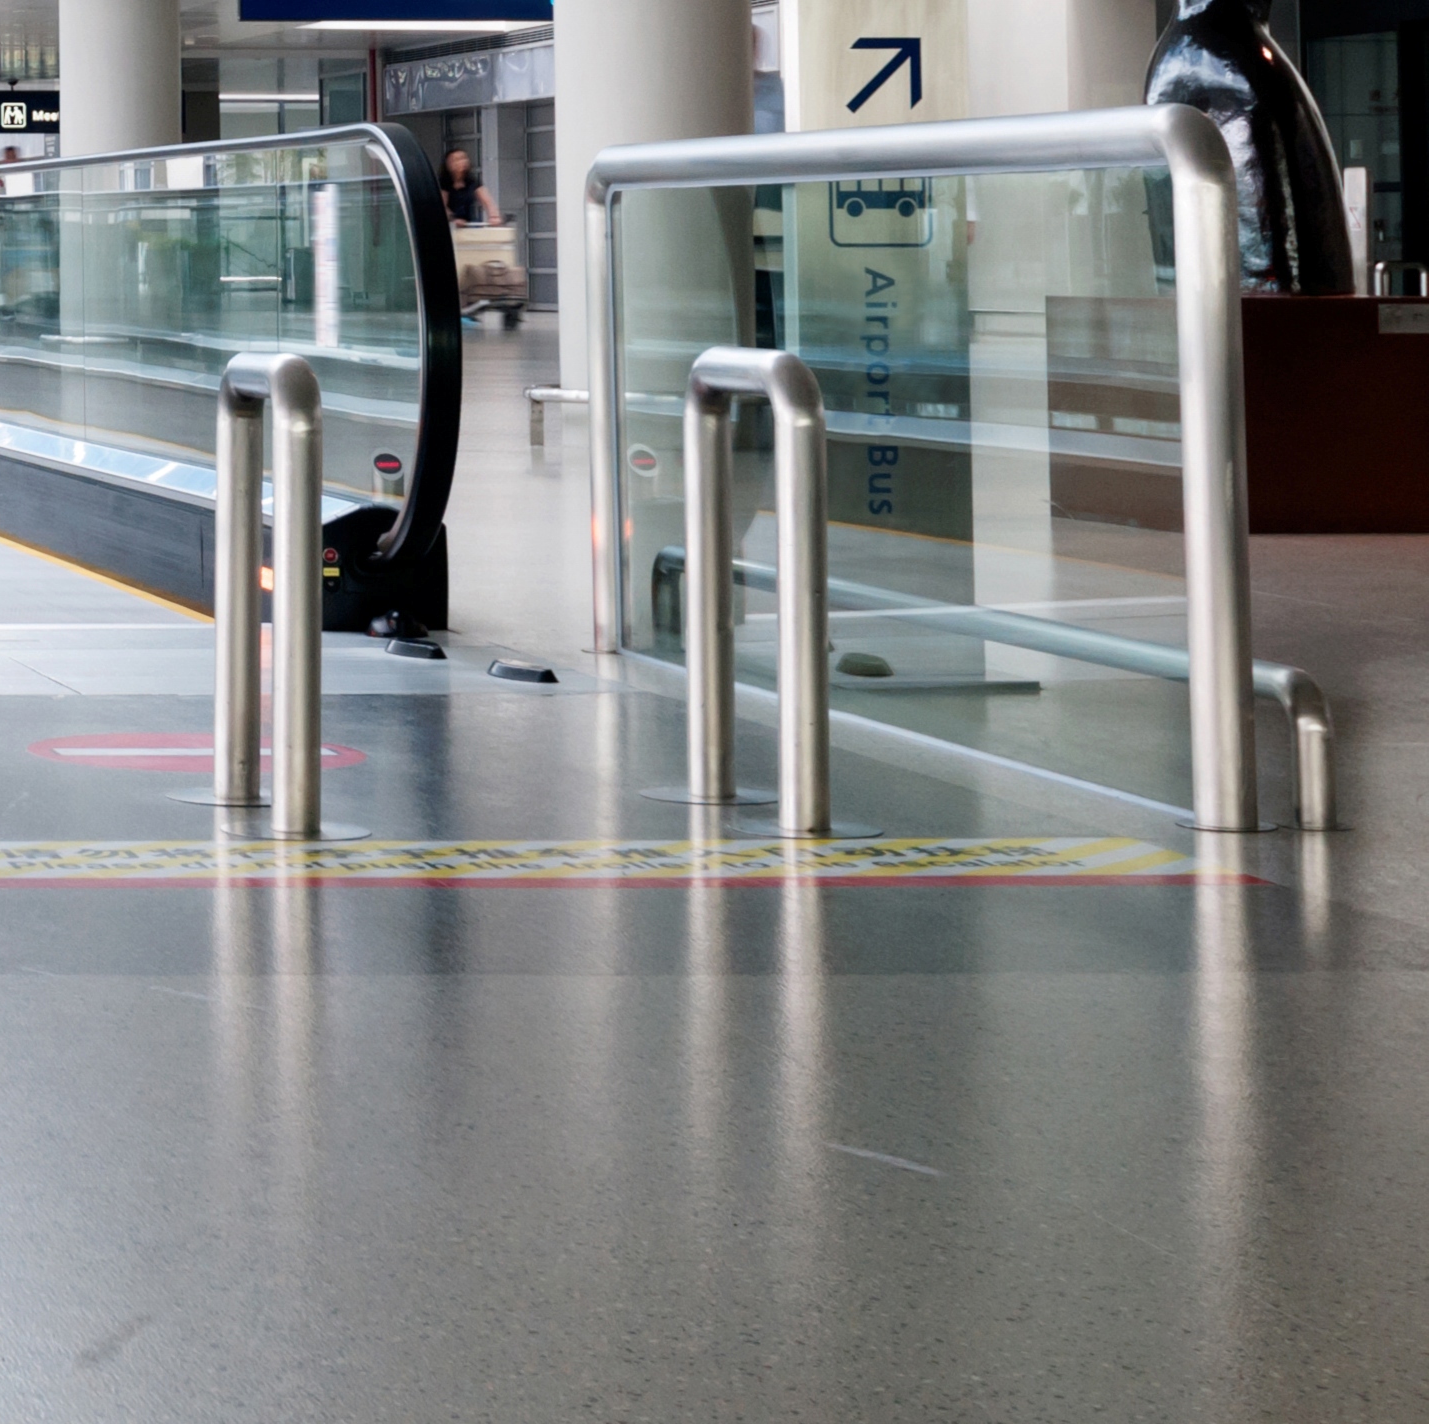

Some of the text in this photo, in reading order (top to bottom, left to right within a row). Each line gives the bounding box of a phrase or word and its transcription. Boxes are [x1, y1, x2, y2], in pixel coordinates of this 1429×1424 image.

[860, 267, 899, 516] Airport Bus
[7, 861, 165, 871] Please
[179, 860, 239, 870] do
[254, 860, 332, 870] not
[337, 860, 458, 872] push
[468, 860, 545, 870] the
[721, 860, 773, 869] to
[871, 858, 1086, 868] escalator
